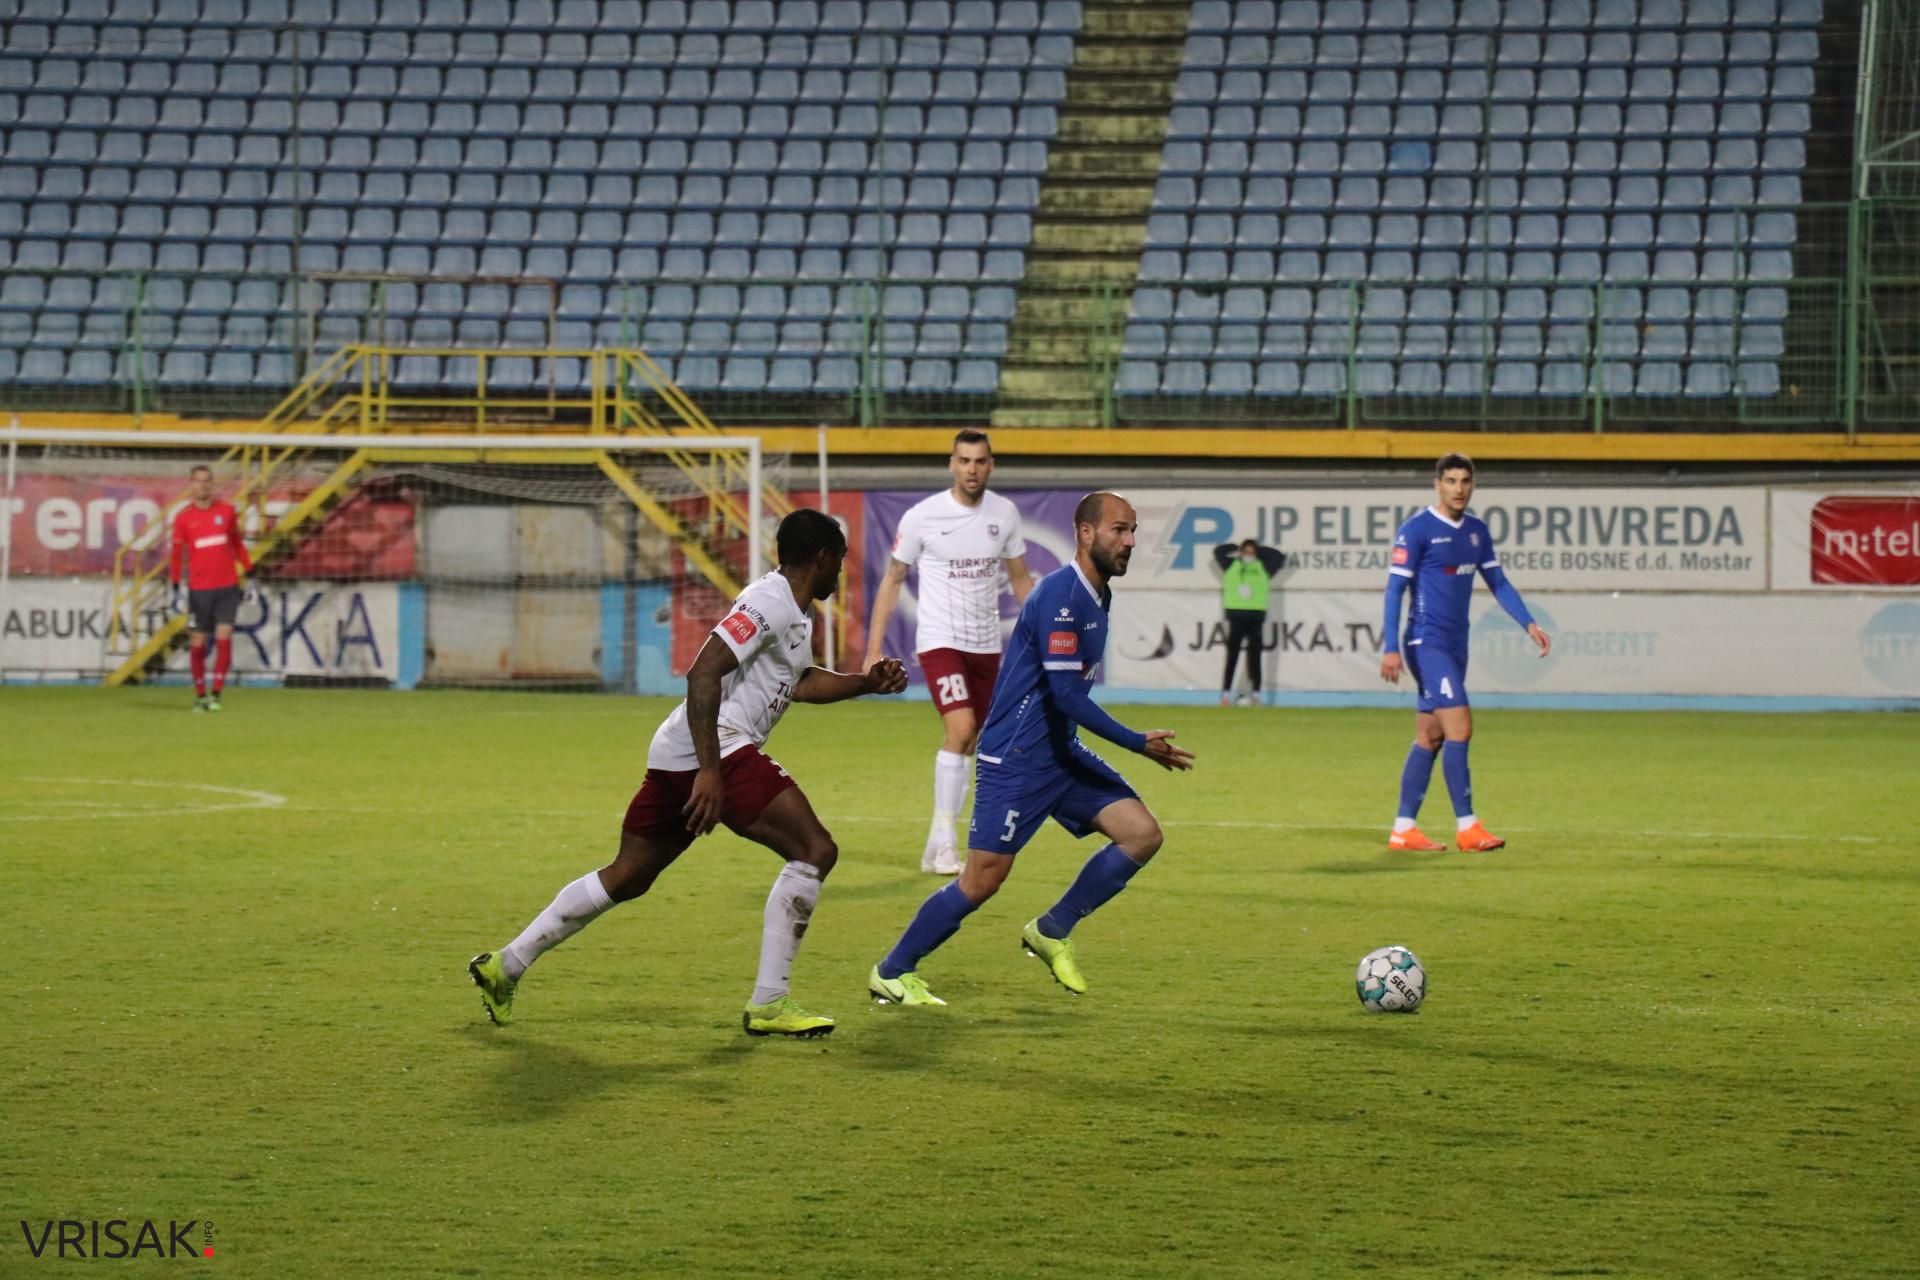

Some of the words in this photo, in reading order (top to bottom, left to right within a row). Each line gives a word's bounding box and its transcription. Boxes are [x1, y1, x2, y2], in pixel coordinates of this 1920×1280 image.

[1256, 506, 1298, 545] JP
[1824, 520, 1920, 557] m:tel
[1560, 552, 1630, 570] BOSNE
[1680, 552, 1752, 571] Mostar
[1189, 622, 1384, 651] JAUKA.TV
[936, 674, 969, 706] 28
[1440, 677, 1453, 699] 4
[1000, 810, 1020, 842] 5
